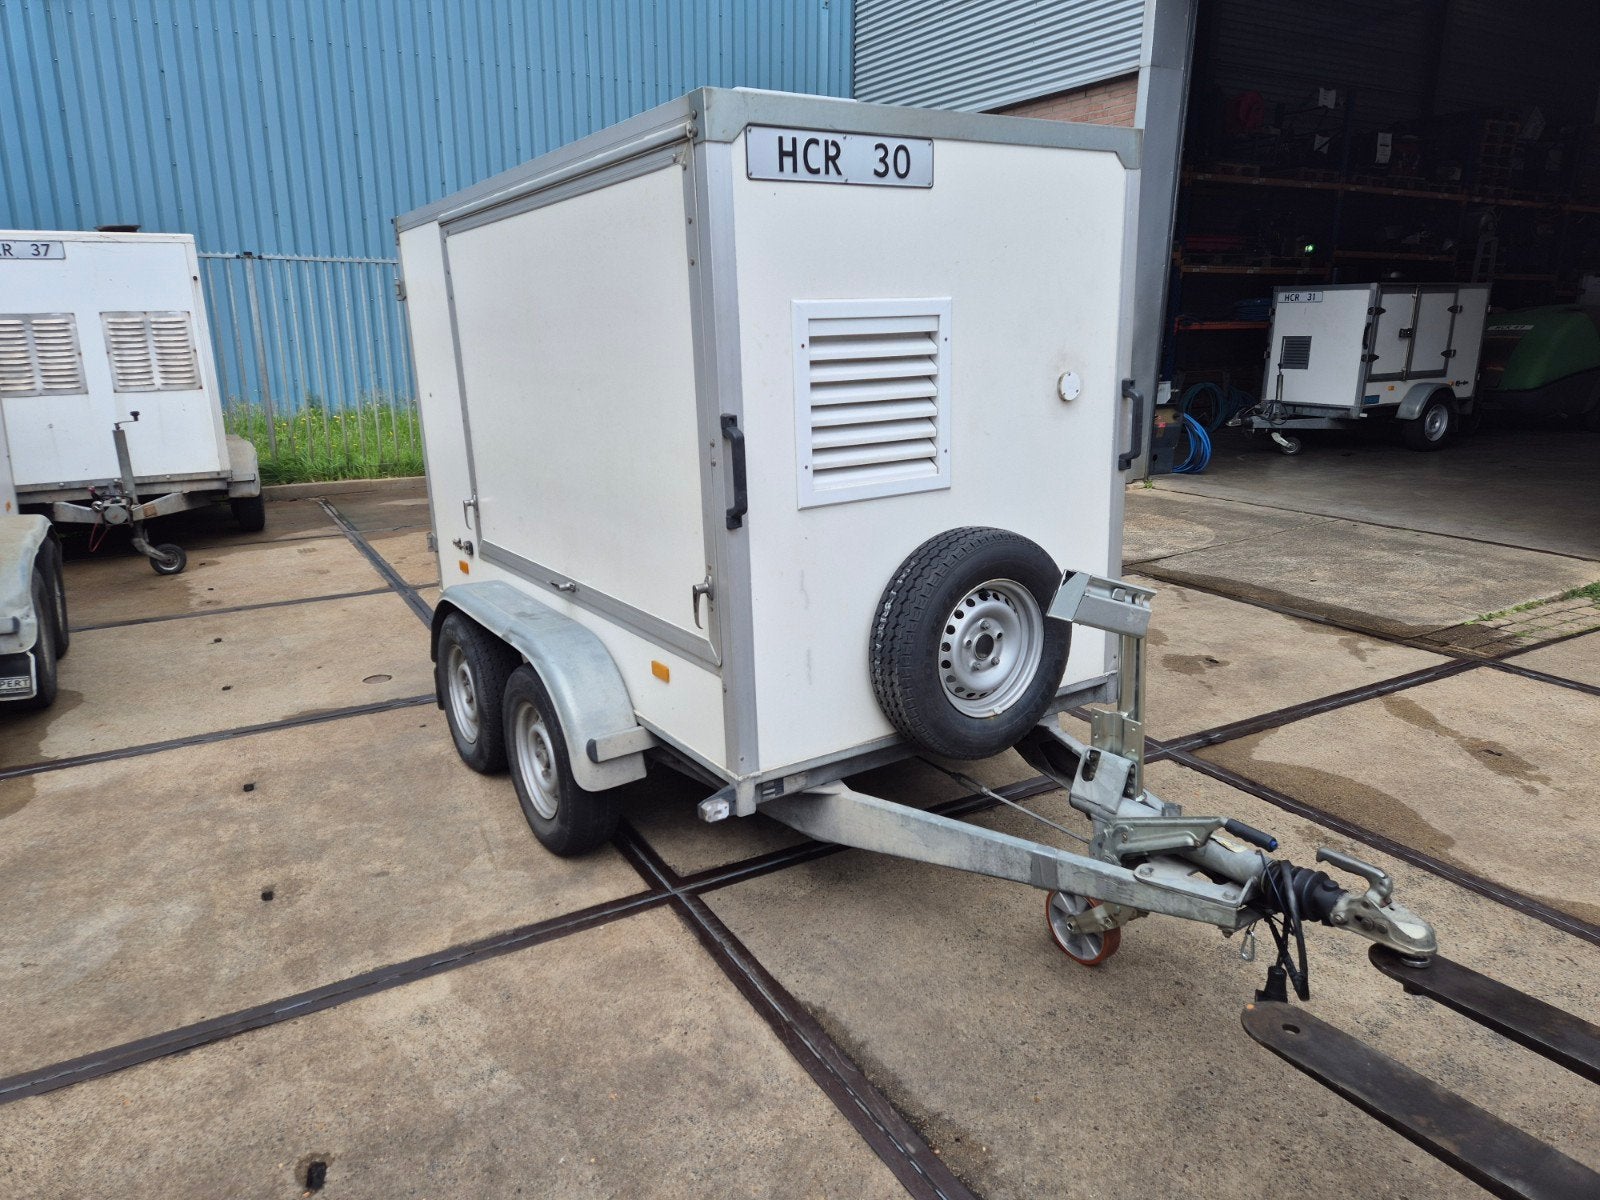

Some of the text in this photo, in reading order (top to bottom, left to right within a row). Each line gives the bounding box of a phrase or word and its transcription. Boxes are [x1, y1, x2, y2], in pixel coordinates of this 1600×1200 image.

[778, 135, 911, 179] HCR 30
[0, 243, 50, 256] R 37
[1284, 292, 1316, 302] HCR 31
